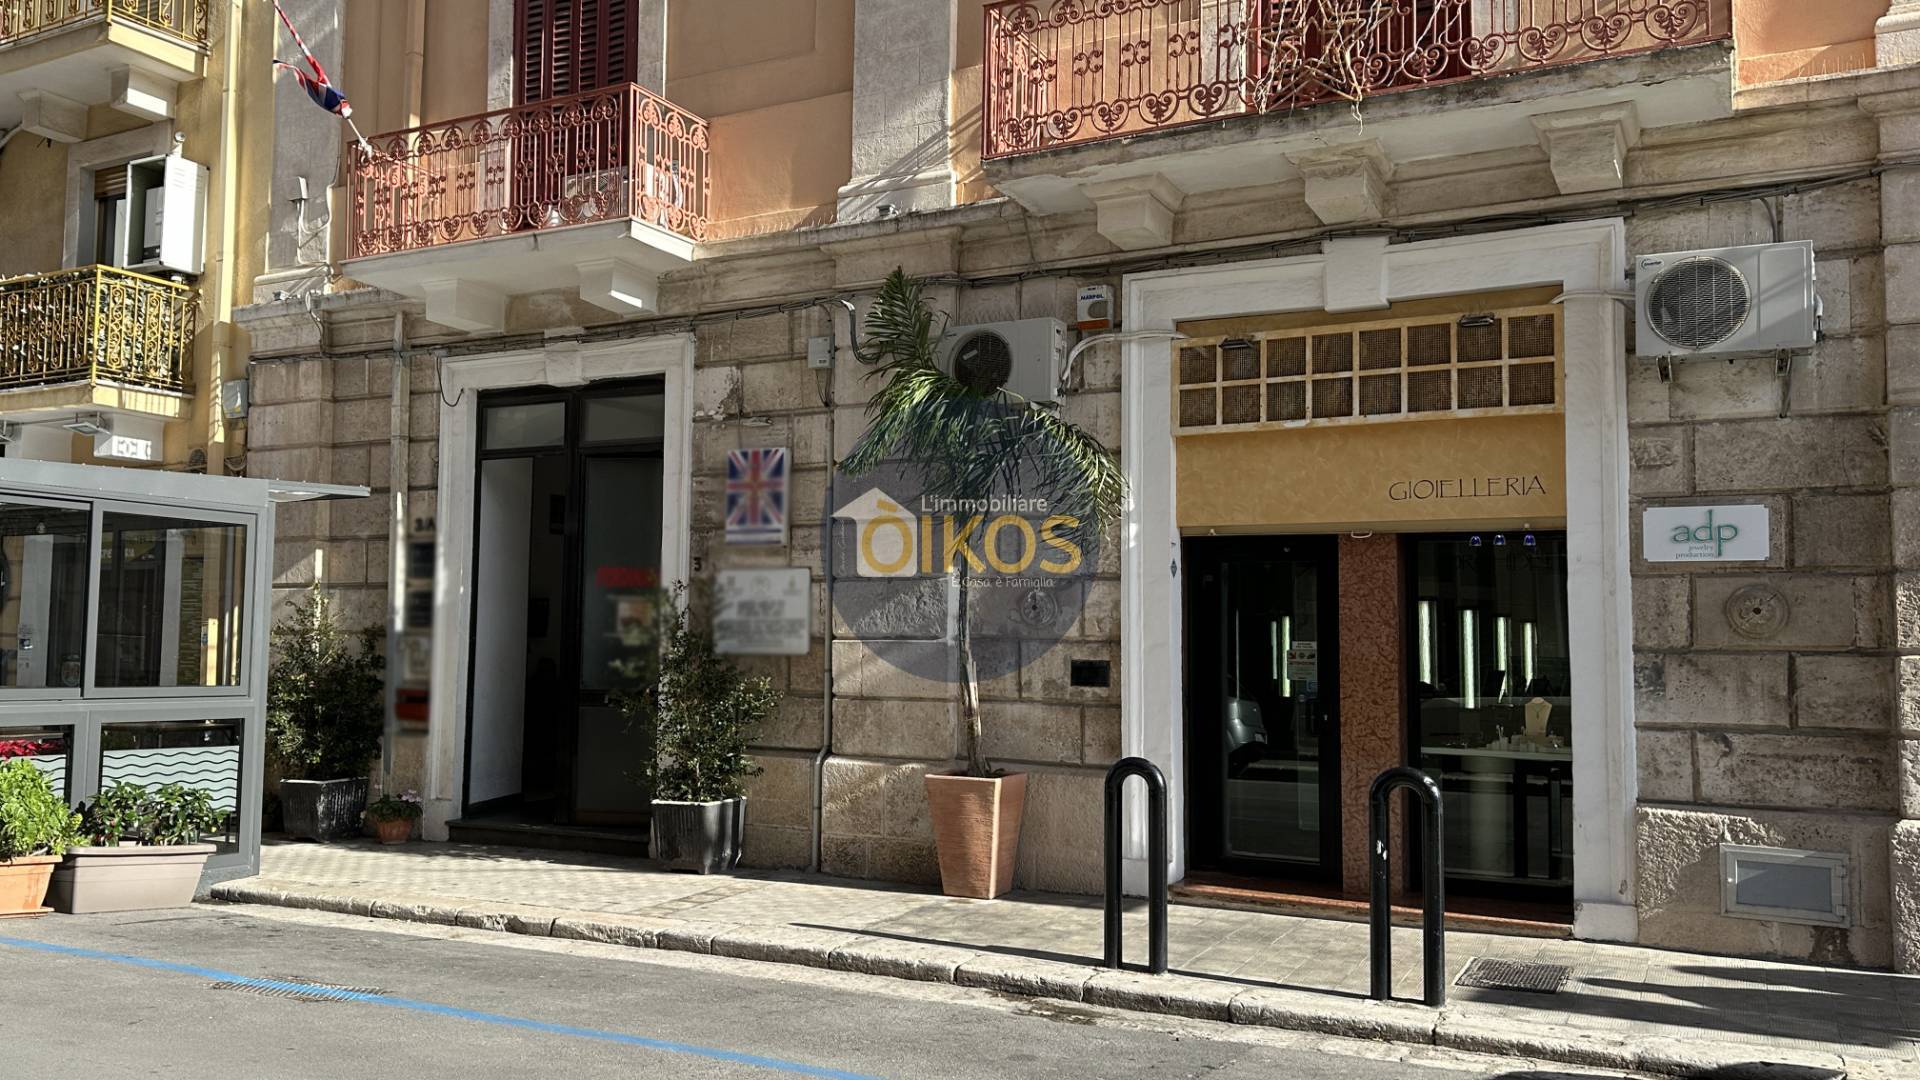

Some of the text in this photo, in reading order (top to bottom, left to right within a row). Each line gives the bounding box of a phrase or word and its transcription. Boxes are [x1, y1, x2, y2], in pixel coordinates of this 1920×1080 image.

[1388, 475, 1547, 501] GIOIELLERIA
[1671, 509, 1738, 557] adp
[693, 556, 702, 572] 3
